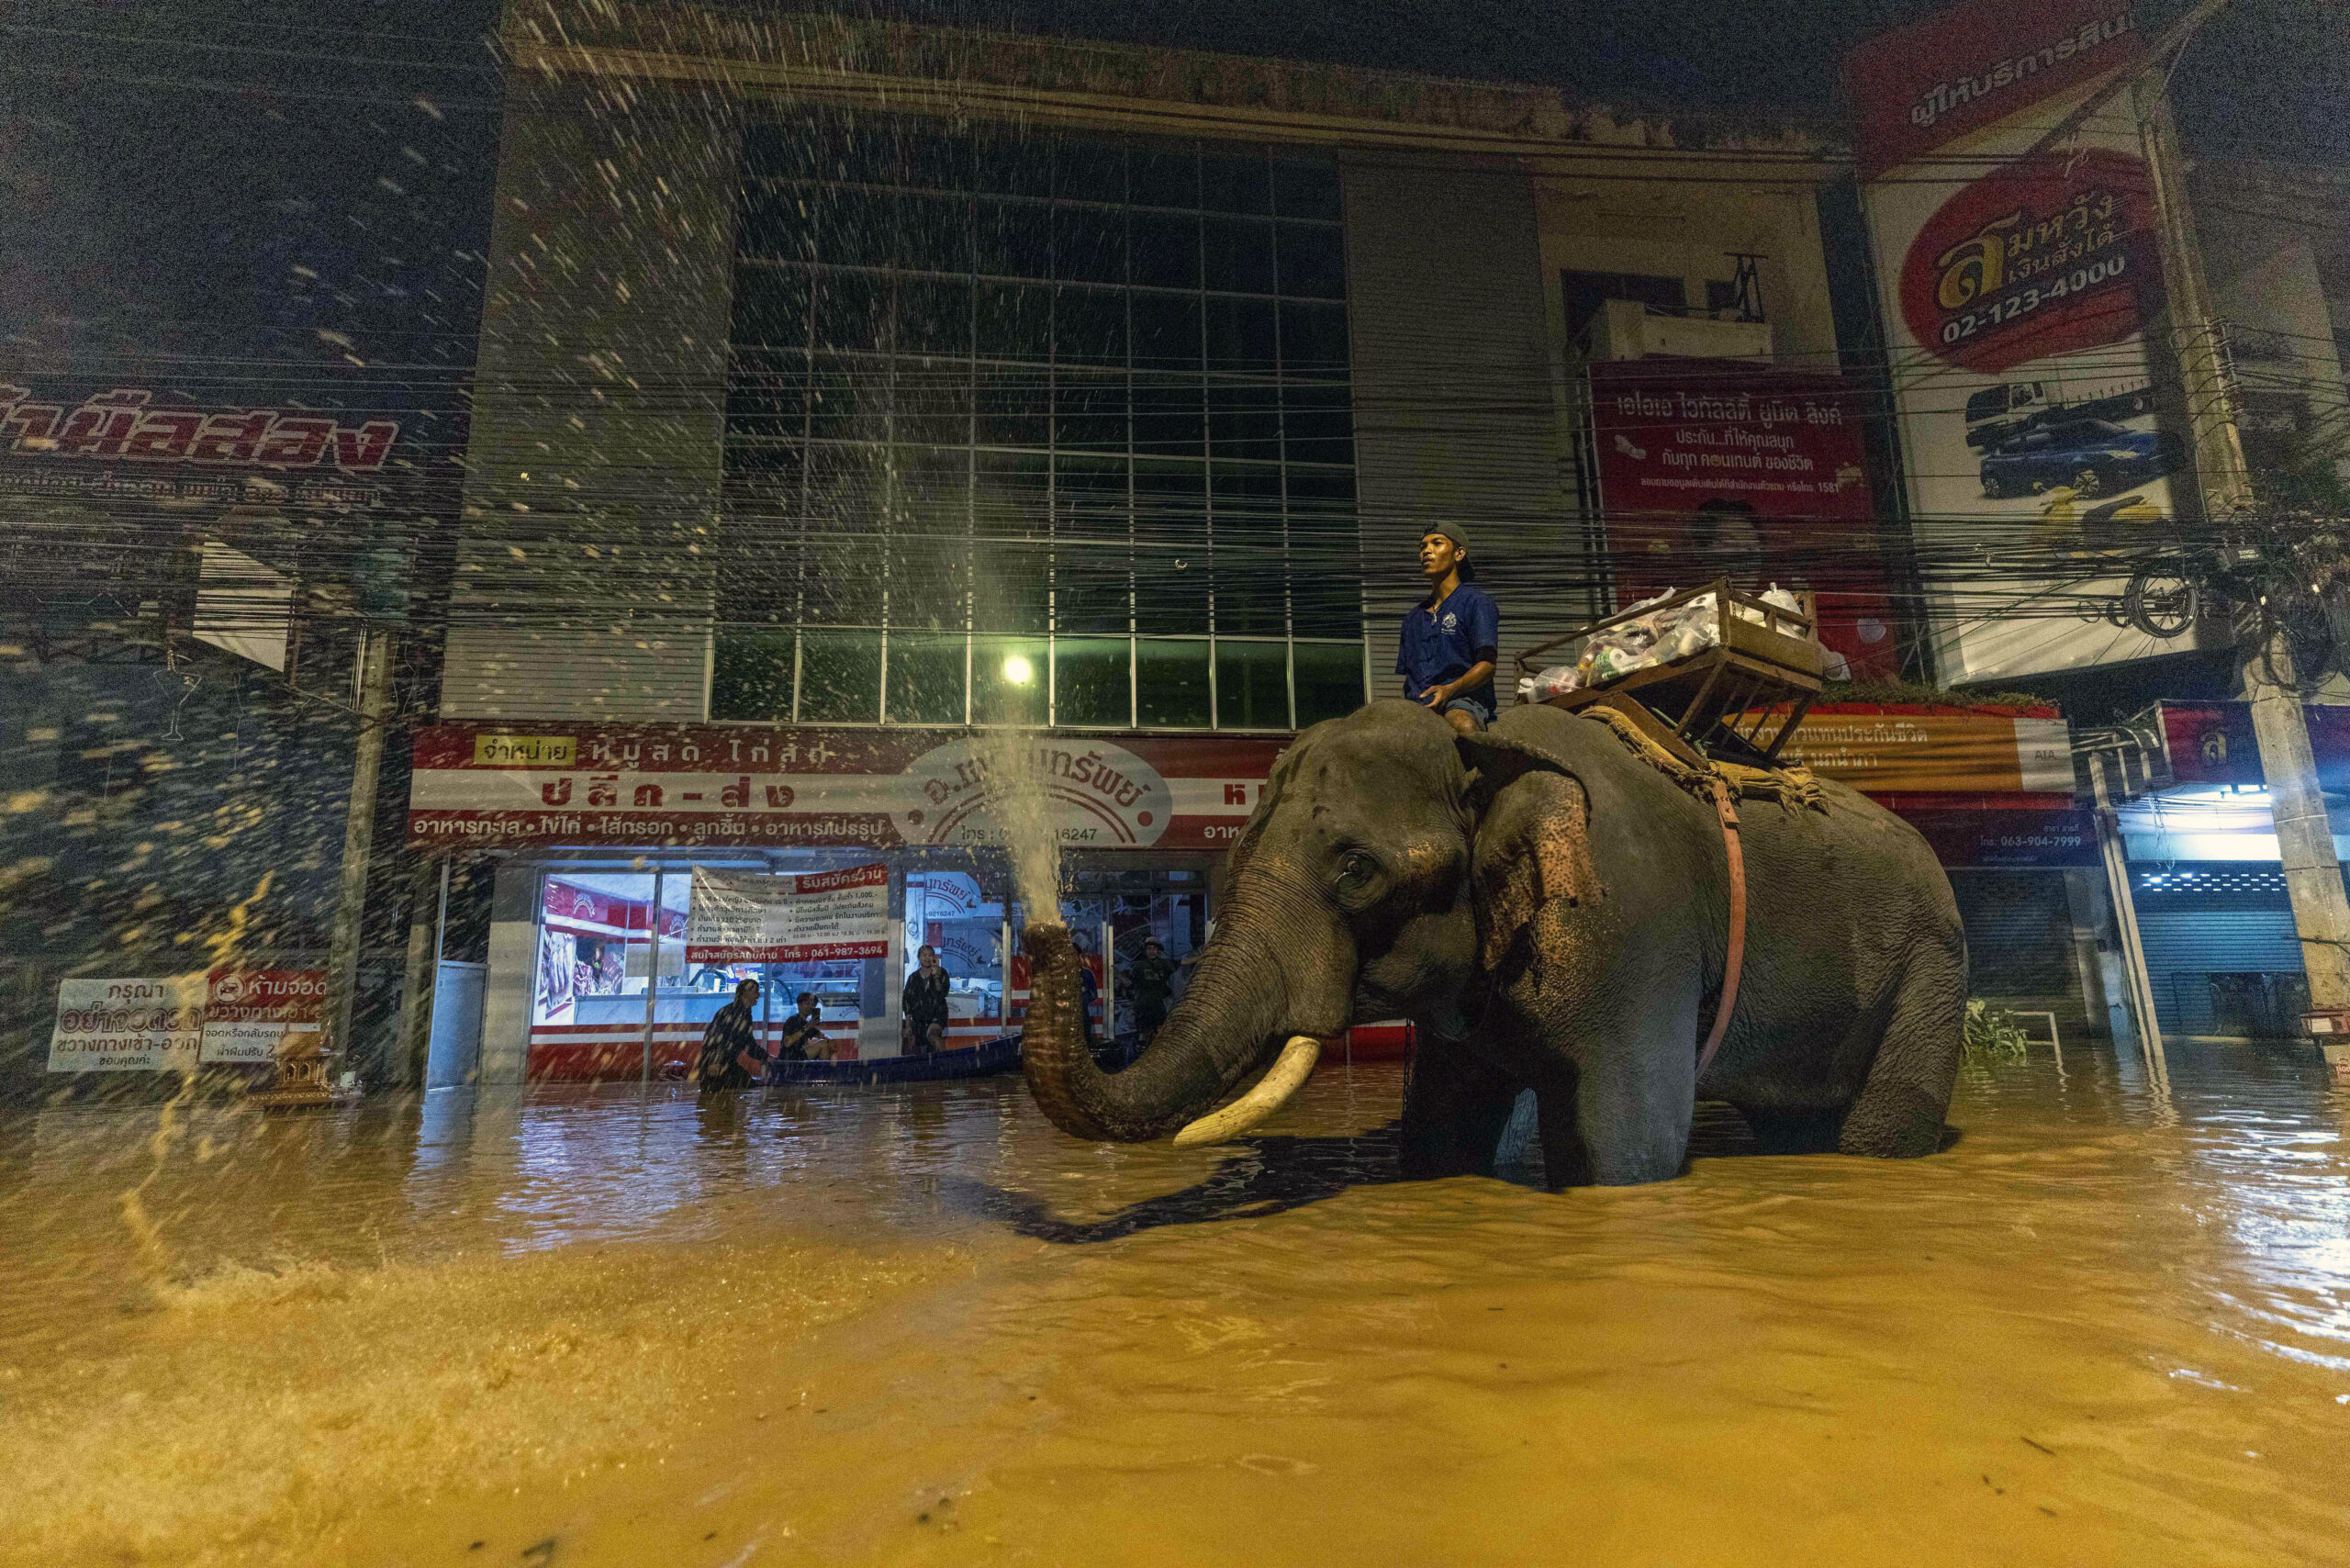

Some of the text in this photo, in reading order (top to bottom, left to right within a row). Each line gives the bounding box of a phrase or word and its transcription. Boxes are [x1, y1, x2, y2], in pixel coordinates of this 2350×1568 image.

[1942, 255, 2126, 343] 02-123-4000
[1662, 448, 1697, 471] กับทุก
[1818, 482, 1839, 493] 1581
[484, 739, 567, 761] จำหน่าย
[592, 741, 699, 768] หมูสด
[2034, 750, 2057, 760] AIA
[414, 818, 520, 835] อาหารทะเล
[540, 814, 581, 834] ไข่ไก่
[599, 814, 674, 835] ไส้กรอก
[693, 812, 746, 840] ลูกชิ้น
[2000, 835, 2082, 847] 063-904-7999
[803, 868, 882, 890] รับสมัครงาน
[811, 946, 883, 958] 061-987-3694
[108, 984, 164, 1005] กรุณา
[249, 974, 328, 995] ห้ามจอด
